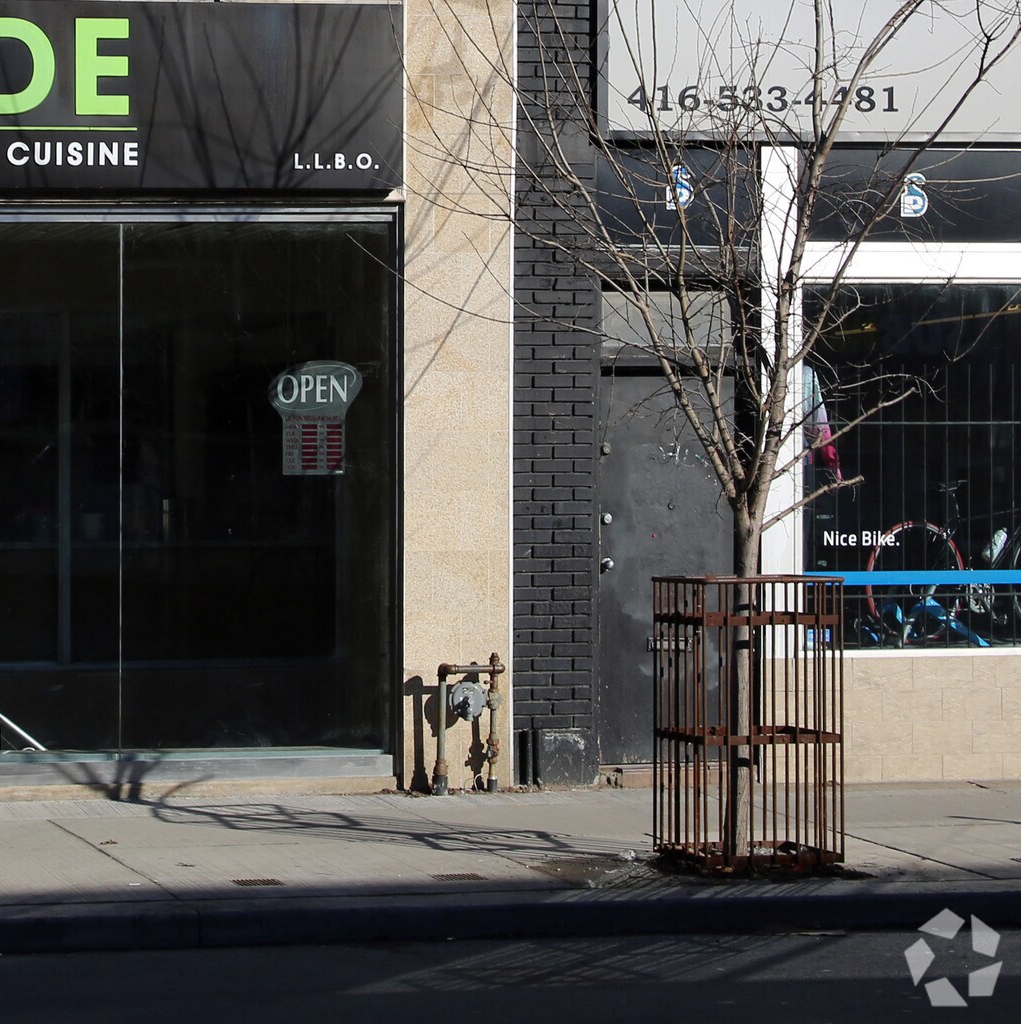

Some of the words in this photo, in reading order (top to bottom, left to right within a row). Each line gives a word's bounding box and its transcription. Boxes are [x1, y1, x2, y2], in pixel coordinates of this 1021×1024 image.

[627, 84, 900, 113] 416-533-4481
[6, 142, 140, 167] CUISINE
[293, 152, 381, 171] L.L.B.O.
[276, 374, 348, 404] OPEN
[822, 530, 858, 546] Nice
[861, 530, 900, 546] Bike.
